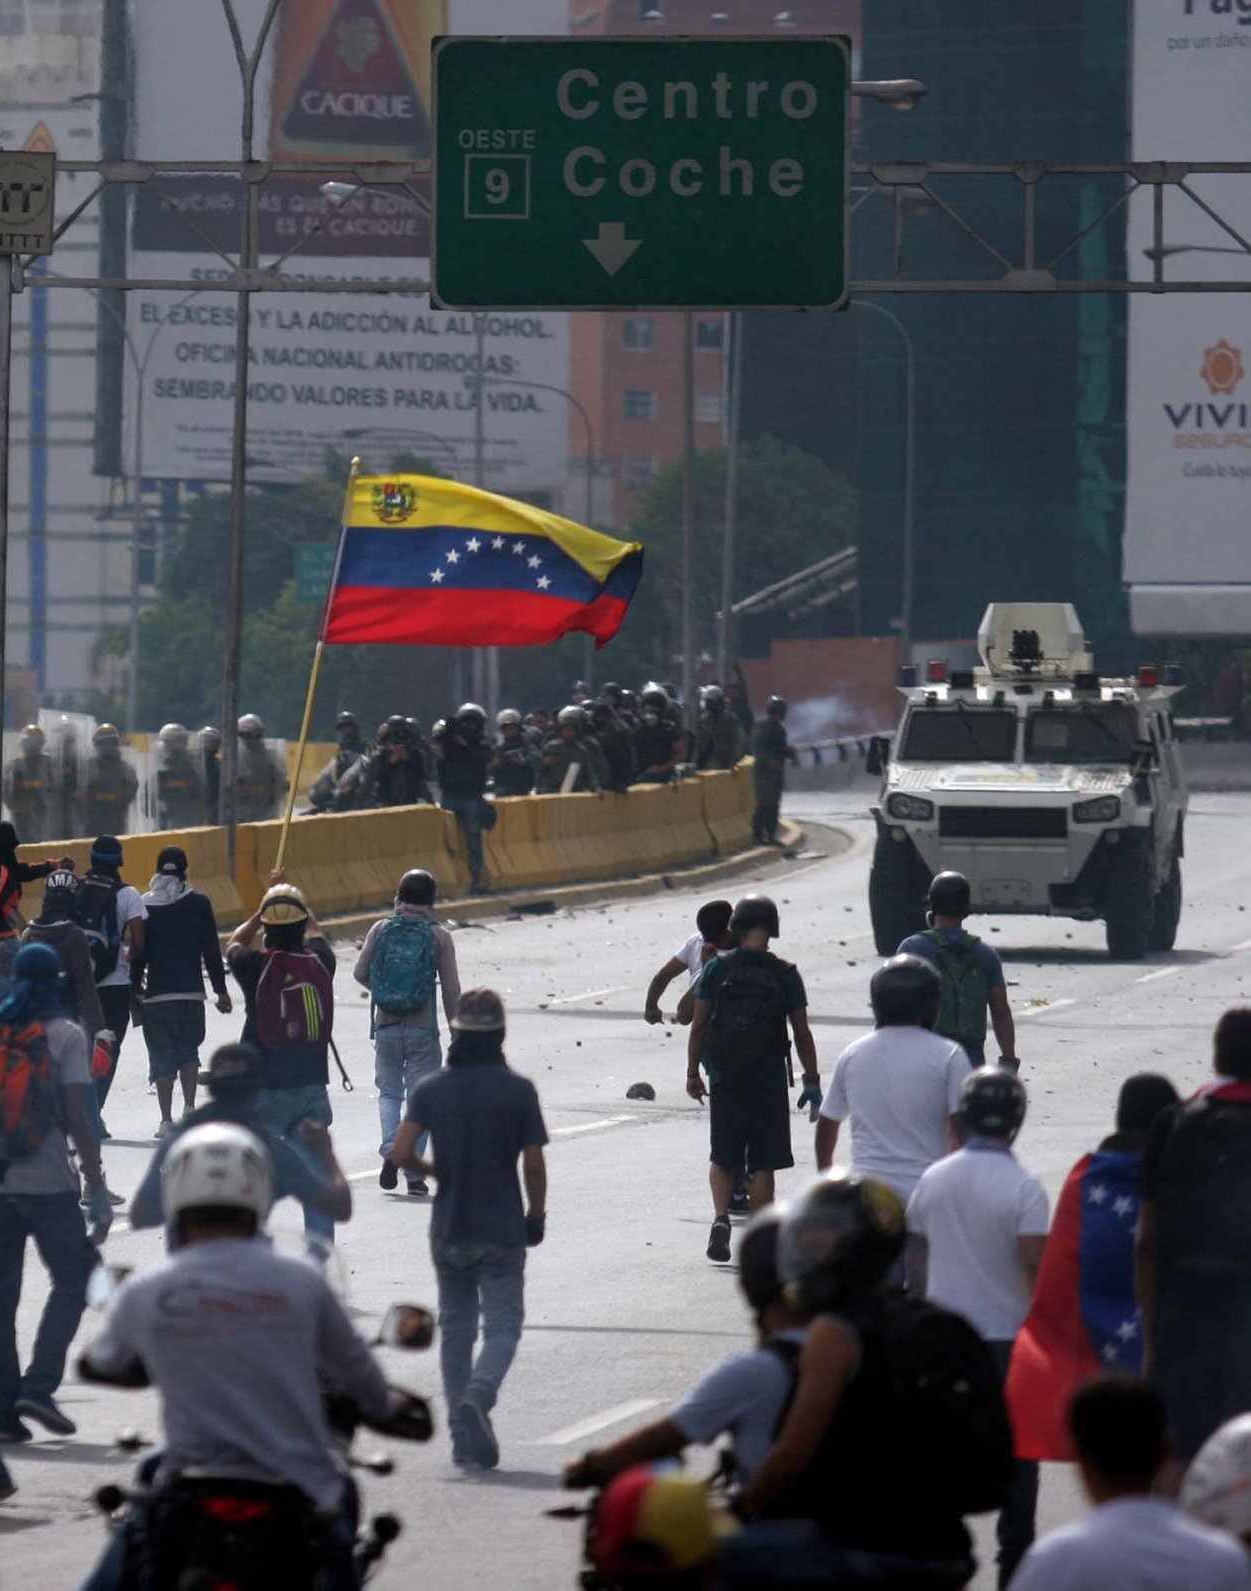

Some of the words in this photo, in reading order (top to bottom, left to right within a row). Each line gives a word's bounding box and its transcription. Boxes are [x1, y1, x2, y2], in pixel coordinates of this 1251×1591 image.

[300, 90, 414, 118] CACIQUE
[557, 69, 818, 120] Centro
[458, 129, 536, 149] OESTE
[484, 169, 511, 204] 9
[562, 146, 804, 197] Coche
[330, 217, 417, 237] CACIQUE
[140, 304, 161, 323] EL
[257, 308, 272, 329] Y
[277, 311, 303, 330] LA
[412, 314, 439, 335] AL
[263, 346, 368, 370] NACIONAL
[292, 384, 389, 408] VALORES
[395, 389, 449, 411] PARA
[454, 392, 482, 412] LA
[487, 392, 544, 414] VIDA.
